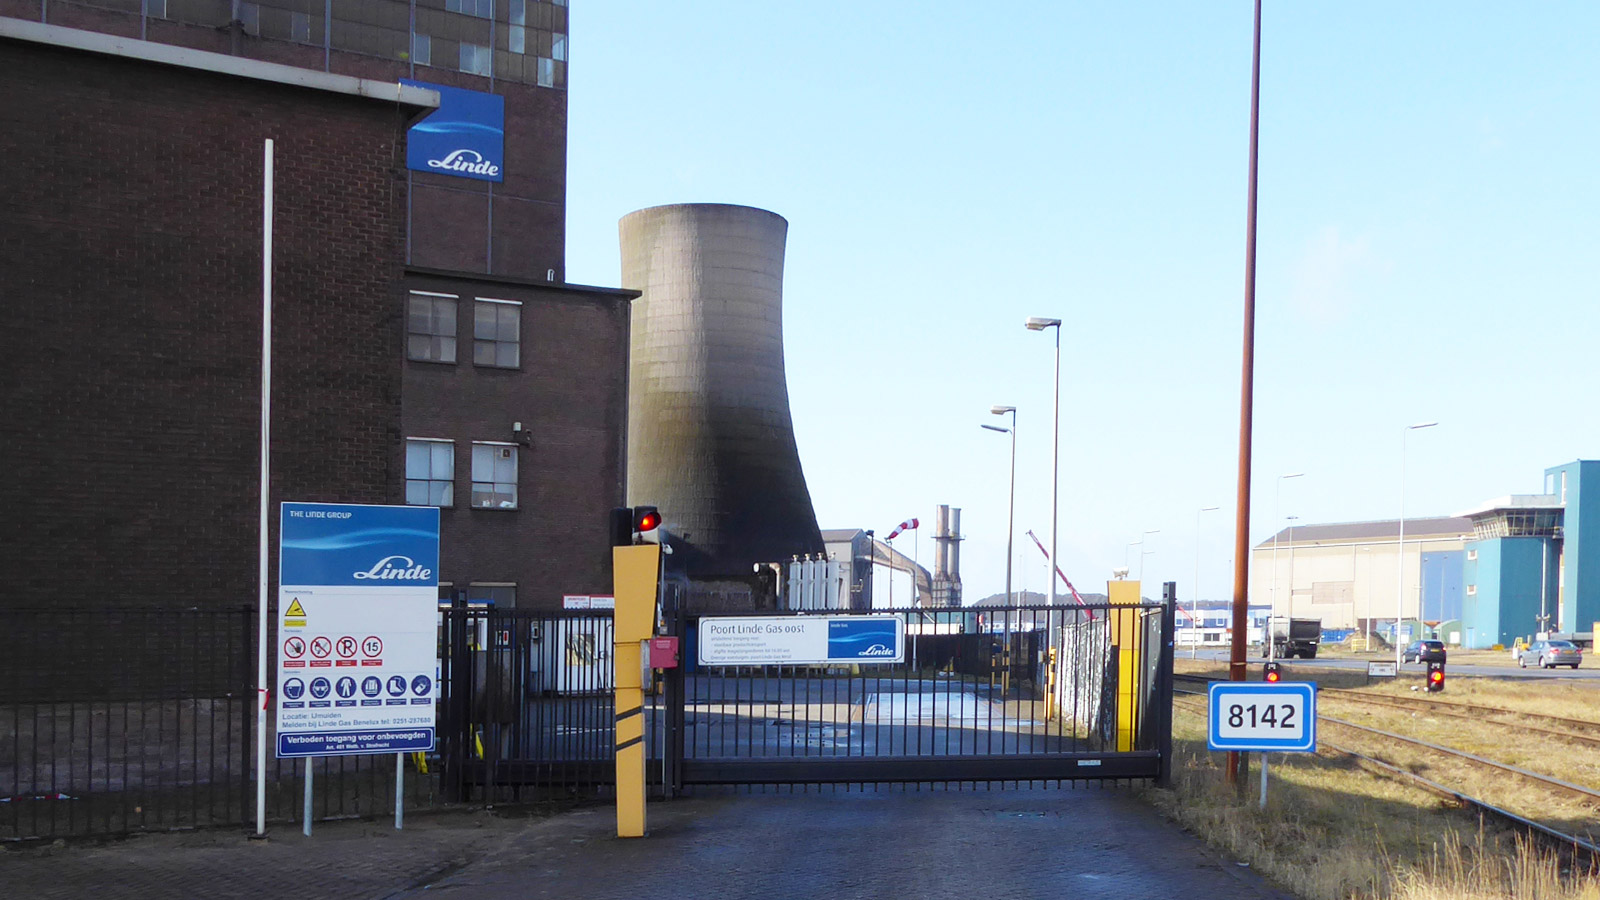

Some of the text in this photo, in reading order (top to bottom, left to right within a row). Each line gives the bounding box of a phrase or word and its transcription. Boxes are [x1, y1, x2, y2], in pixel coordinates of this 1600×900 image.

[427, 149, 499, 176] Linde
[326, 511, 352, 519] GROUP
[353, 555, 431, 580] Linde
[710, 624, 805, 634] Poort Linde Gas oost
[366, 642, 379, 652] 15
[858, 644, 894, 656] Linde
[1228, 704, 1295, 729] 8142
[308, 721, 317, 729] bij
[286, 736, 324, 744] Verboden
[326, 735, 356, 744] toegang
[376, 732, 426, 741] onbevoegden
